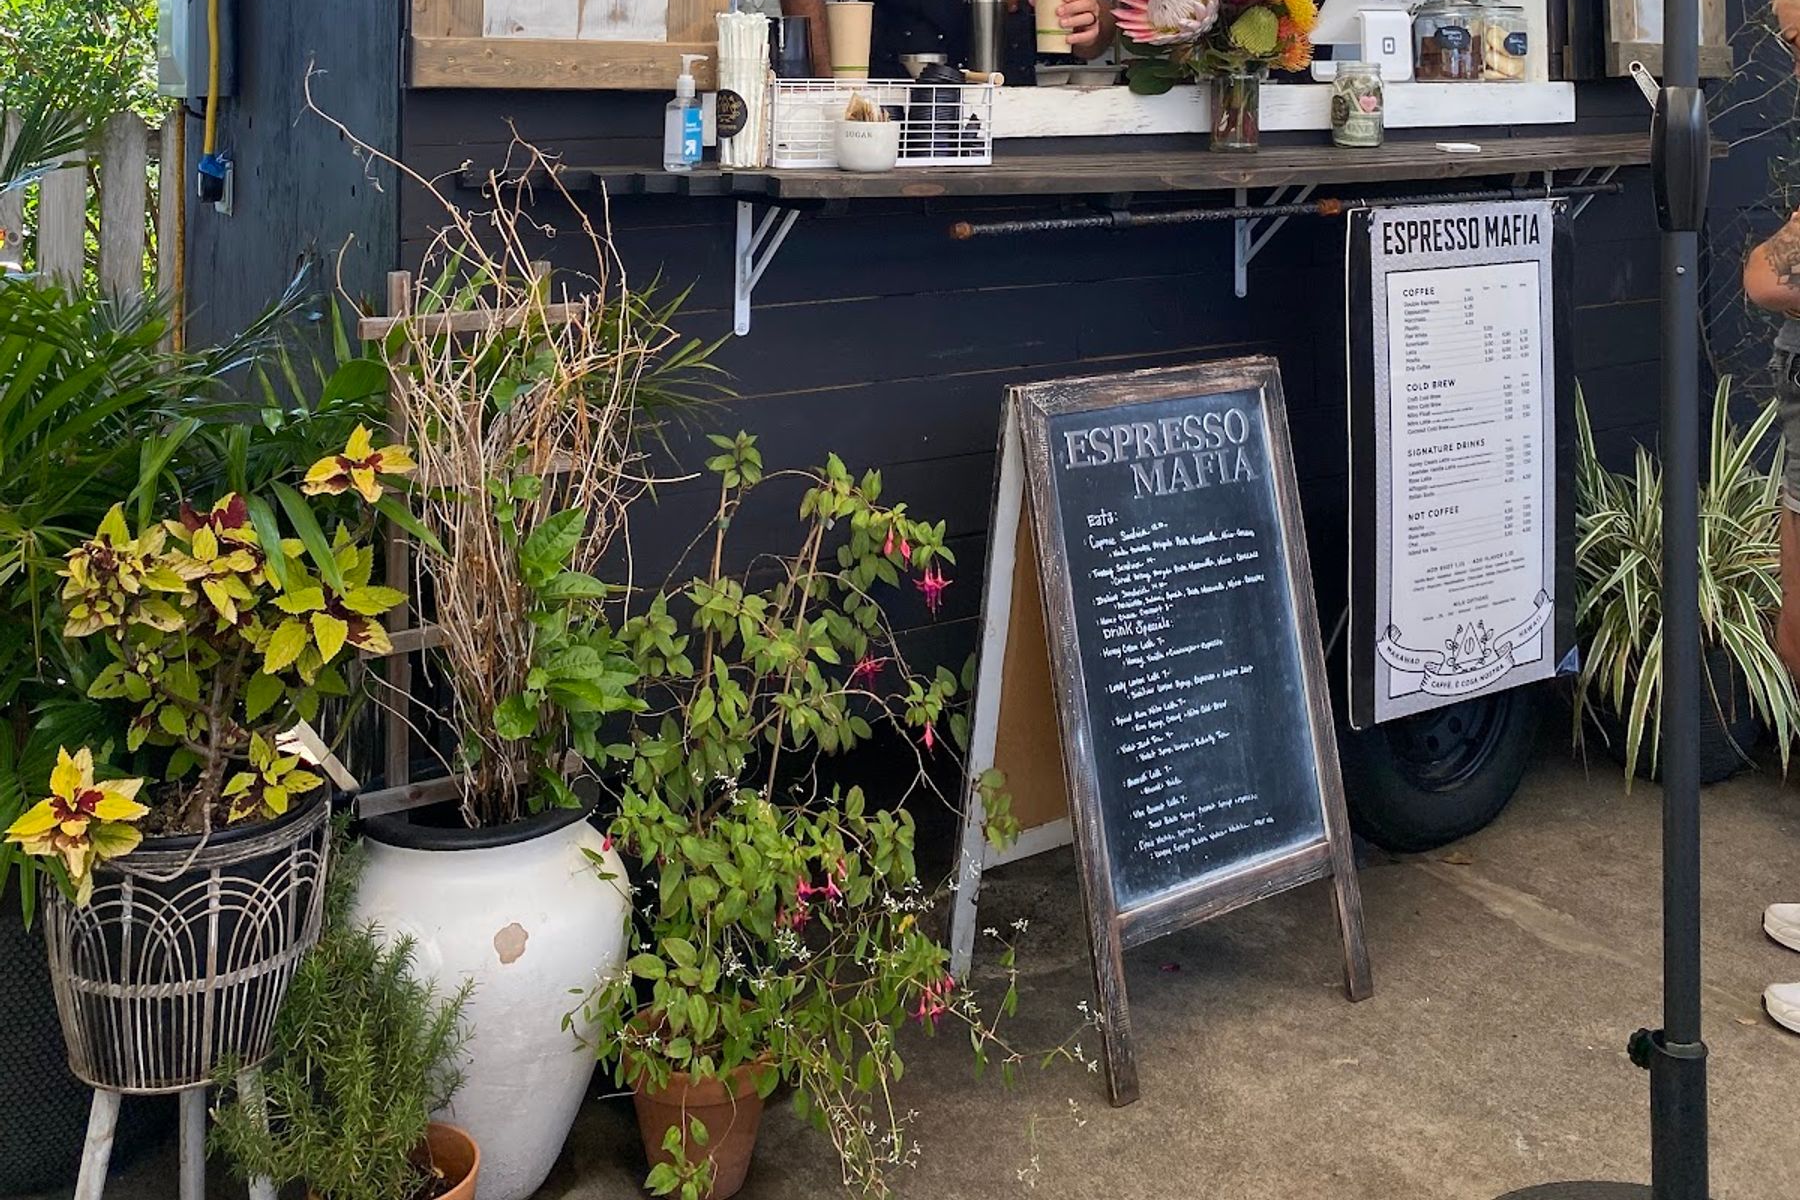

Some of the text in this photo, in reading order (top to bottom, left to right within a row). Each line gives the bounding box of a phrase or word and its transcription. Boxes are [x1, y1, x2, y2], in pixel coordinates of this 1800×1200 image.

[1383, 213, 1540, 255] ESPRESSO MAFIA
[1402, 286, 1435, 297] COFFEE
[1406, 379, 1456, 392] COLD BREW
[1064, 408, 1250, 469] ESPRESSO
[1407, 443, 1453, 457] SIGNATURE
[1456, 438, 1485, 450] DRINKS
[1130, 446, 1260, 499] MAFIA
[1408, 505, 1459, 521] NOT COFFEE
[1386, 646, 1420, 664] MAKAWAO
[1461, 677, 1478, 687] COSA
[1481, 664, 1504, 681] NOSTRA
